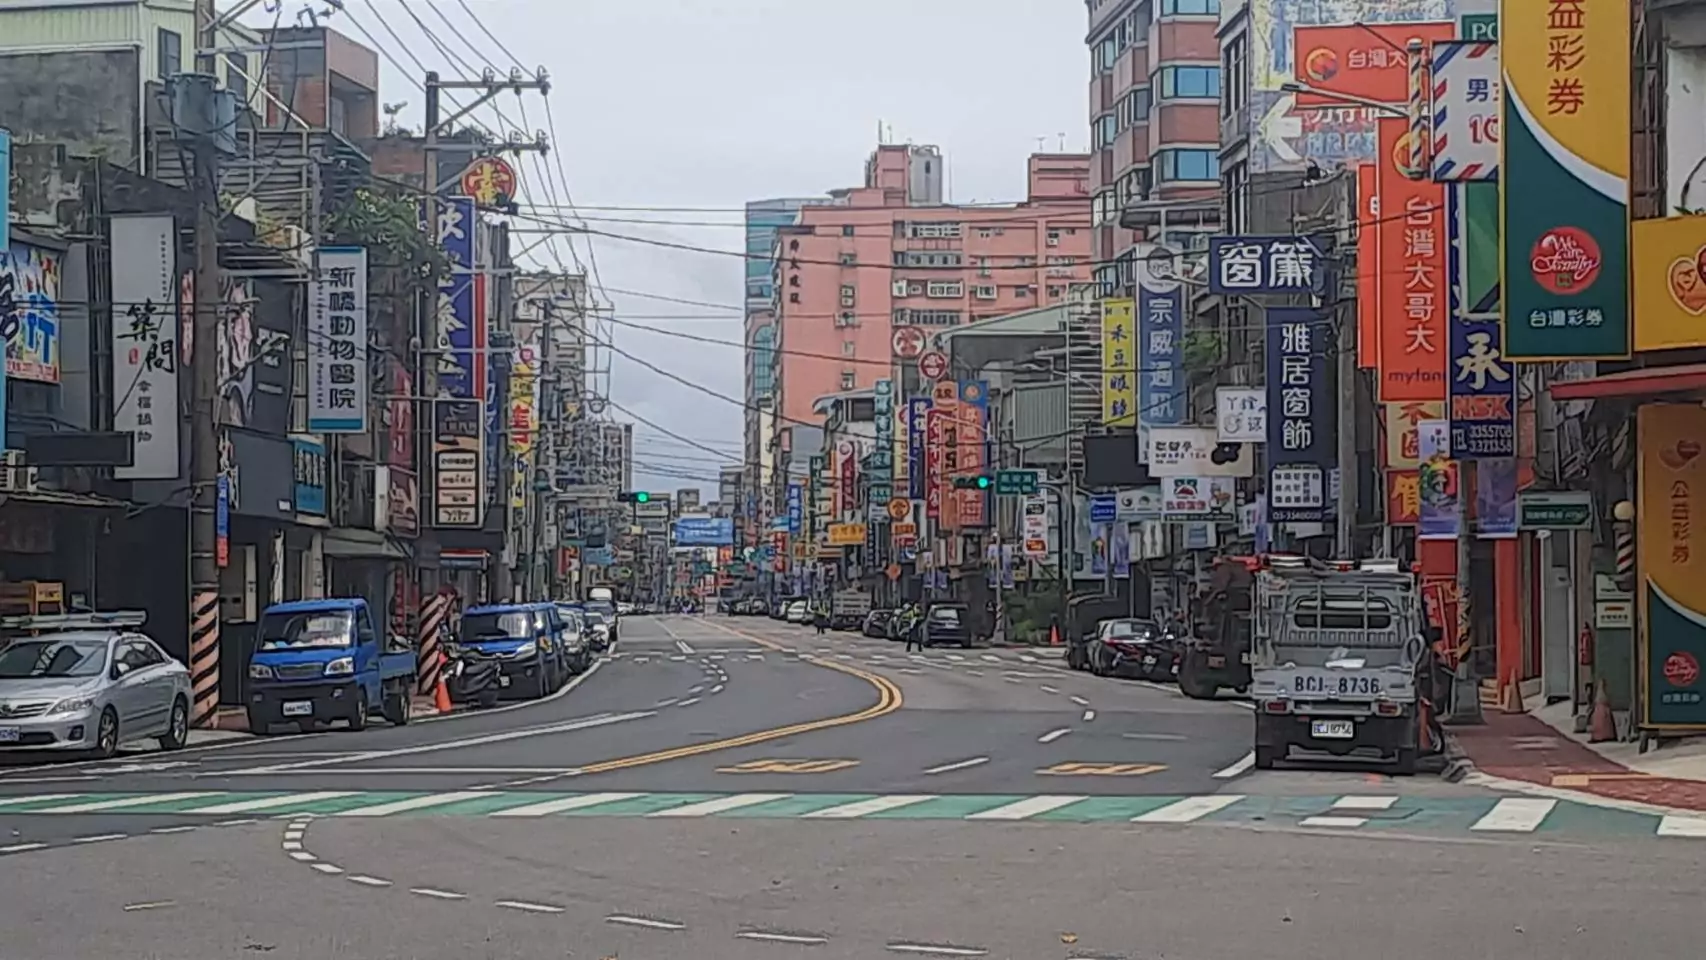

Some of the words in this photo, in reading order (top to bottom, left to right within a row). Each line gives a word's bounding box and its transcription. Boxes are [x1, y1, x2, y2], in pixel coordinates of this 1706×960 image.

[1218, 242, 1313, 288] 窗簾
[1404, 197, 1436, 354] 台灣大哥大
[1530, 308, 1603, 328] 台灣彩券
[1148, 298, 1174, 418] 宗威通訊
[1281, 323, 1312, 450] 雅居窗飾
[1455, 333, 1511, 391] 承
[1452, 394, 1512, 421] NSK
[1670, 479, 1691, 564] 公益彩券
